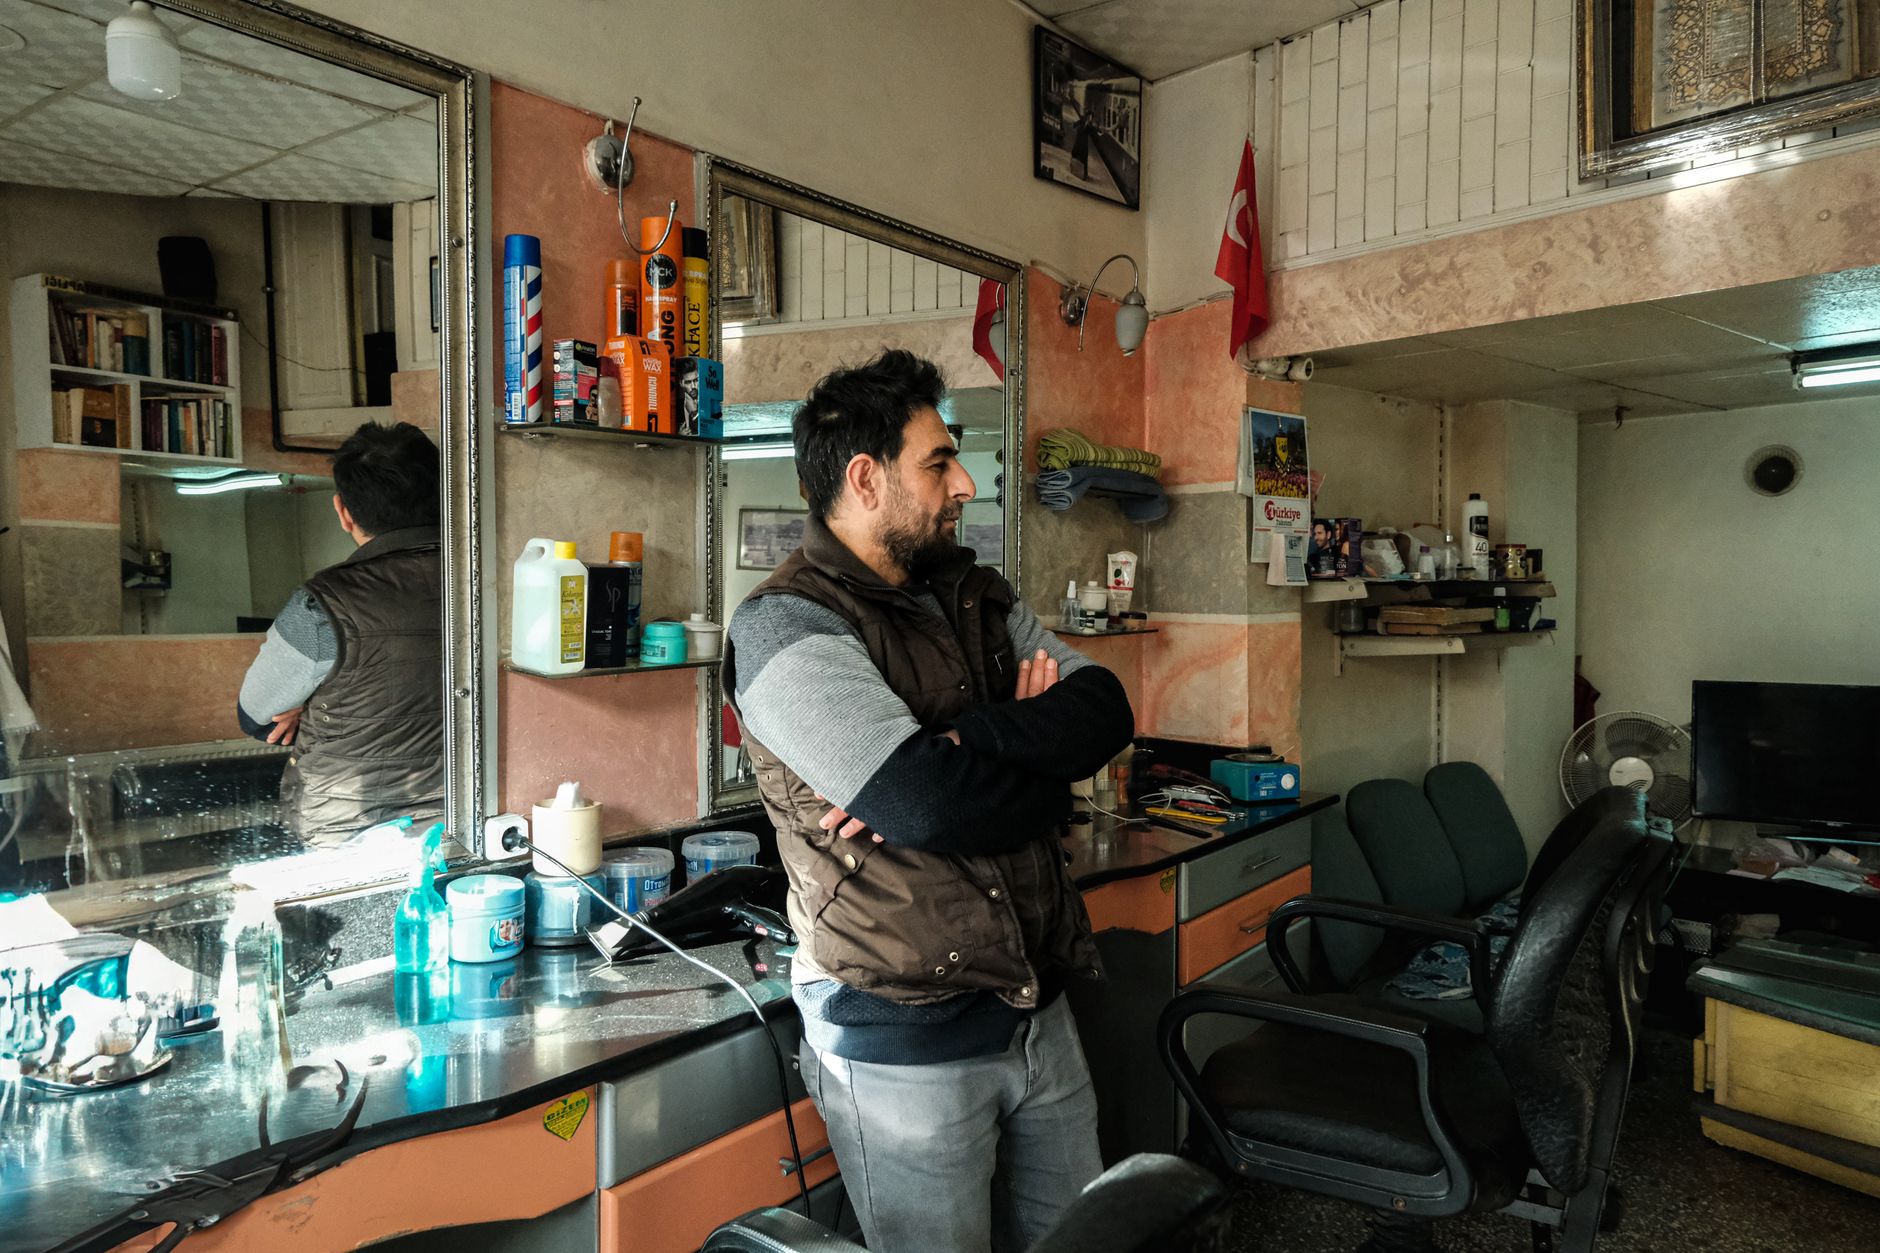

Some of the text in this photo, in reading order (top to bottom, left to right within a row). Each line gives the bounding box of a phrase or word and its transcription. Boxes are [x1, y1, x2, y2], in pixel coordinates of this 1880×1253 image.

[708, 366, 717, 378] So
[705, 377, 720, 391] Well
[1475, 541, 1488, 553] 40
